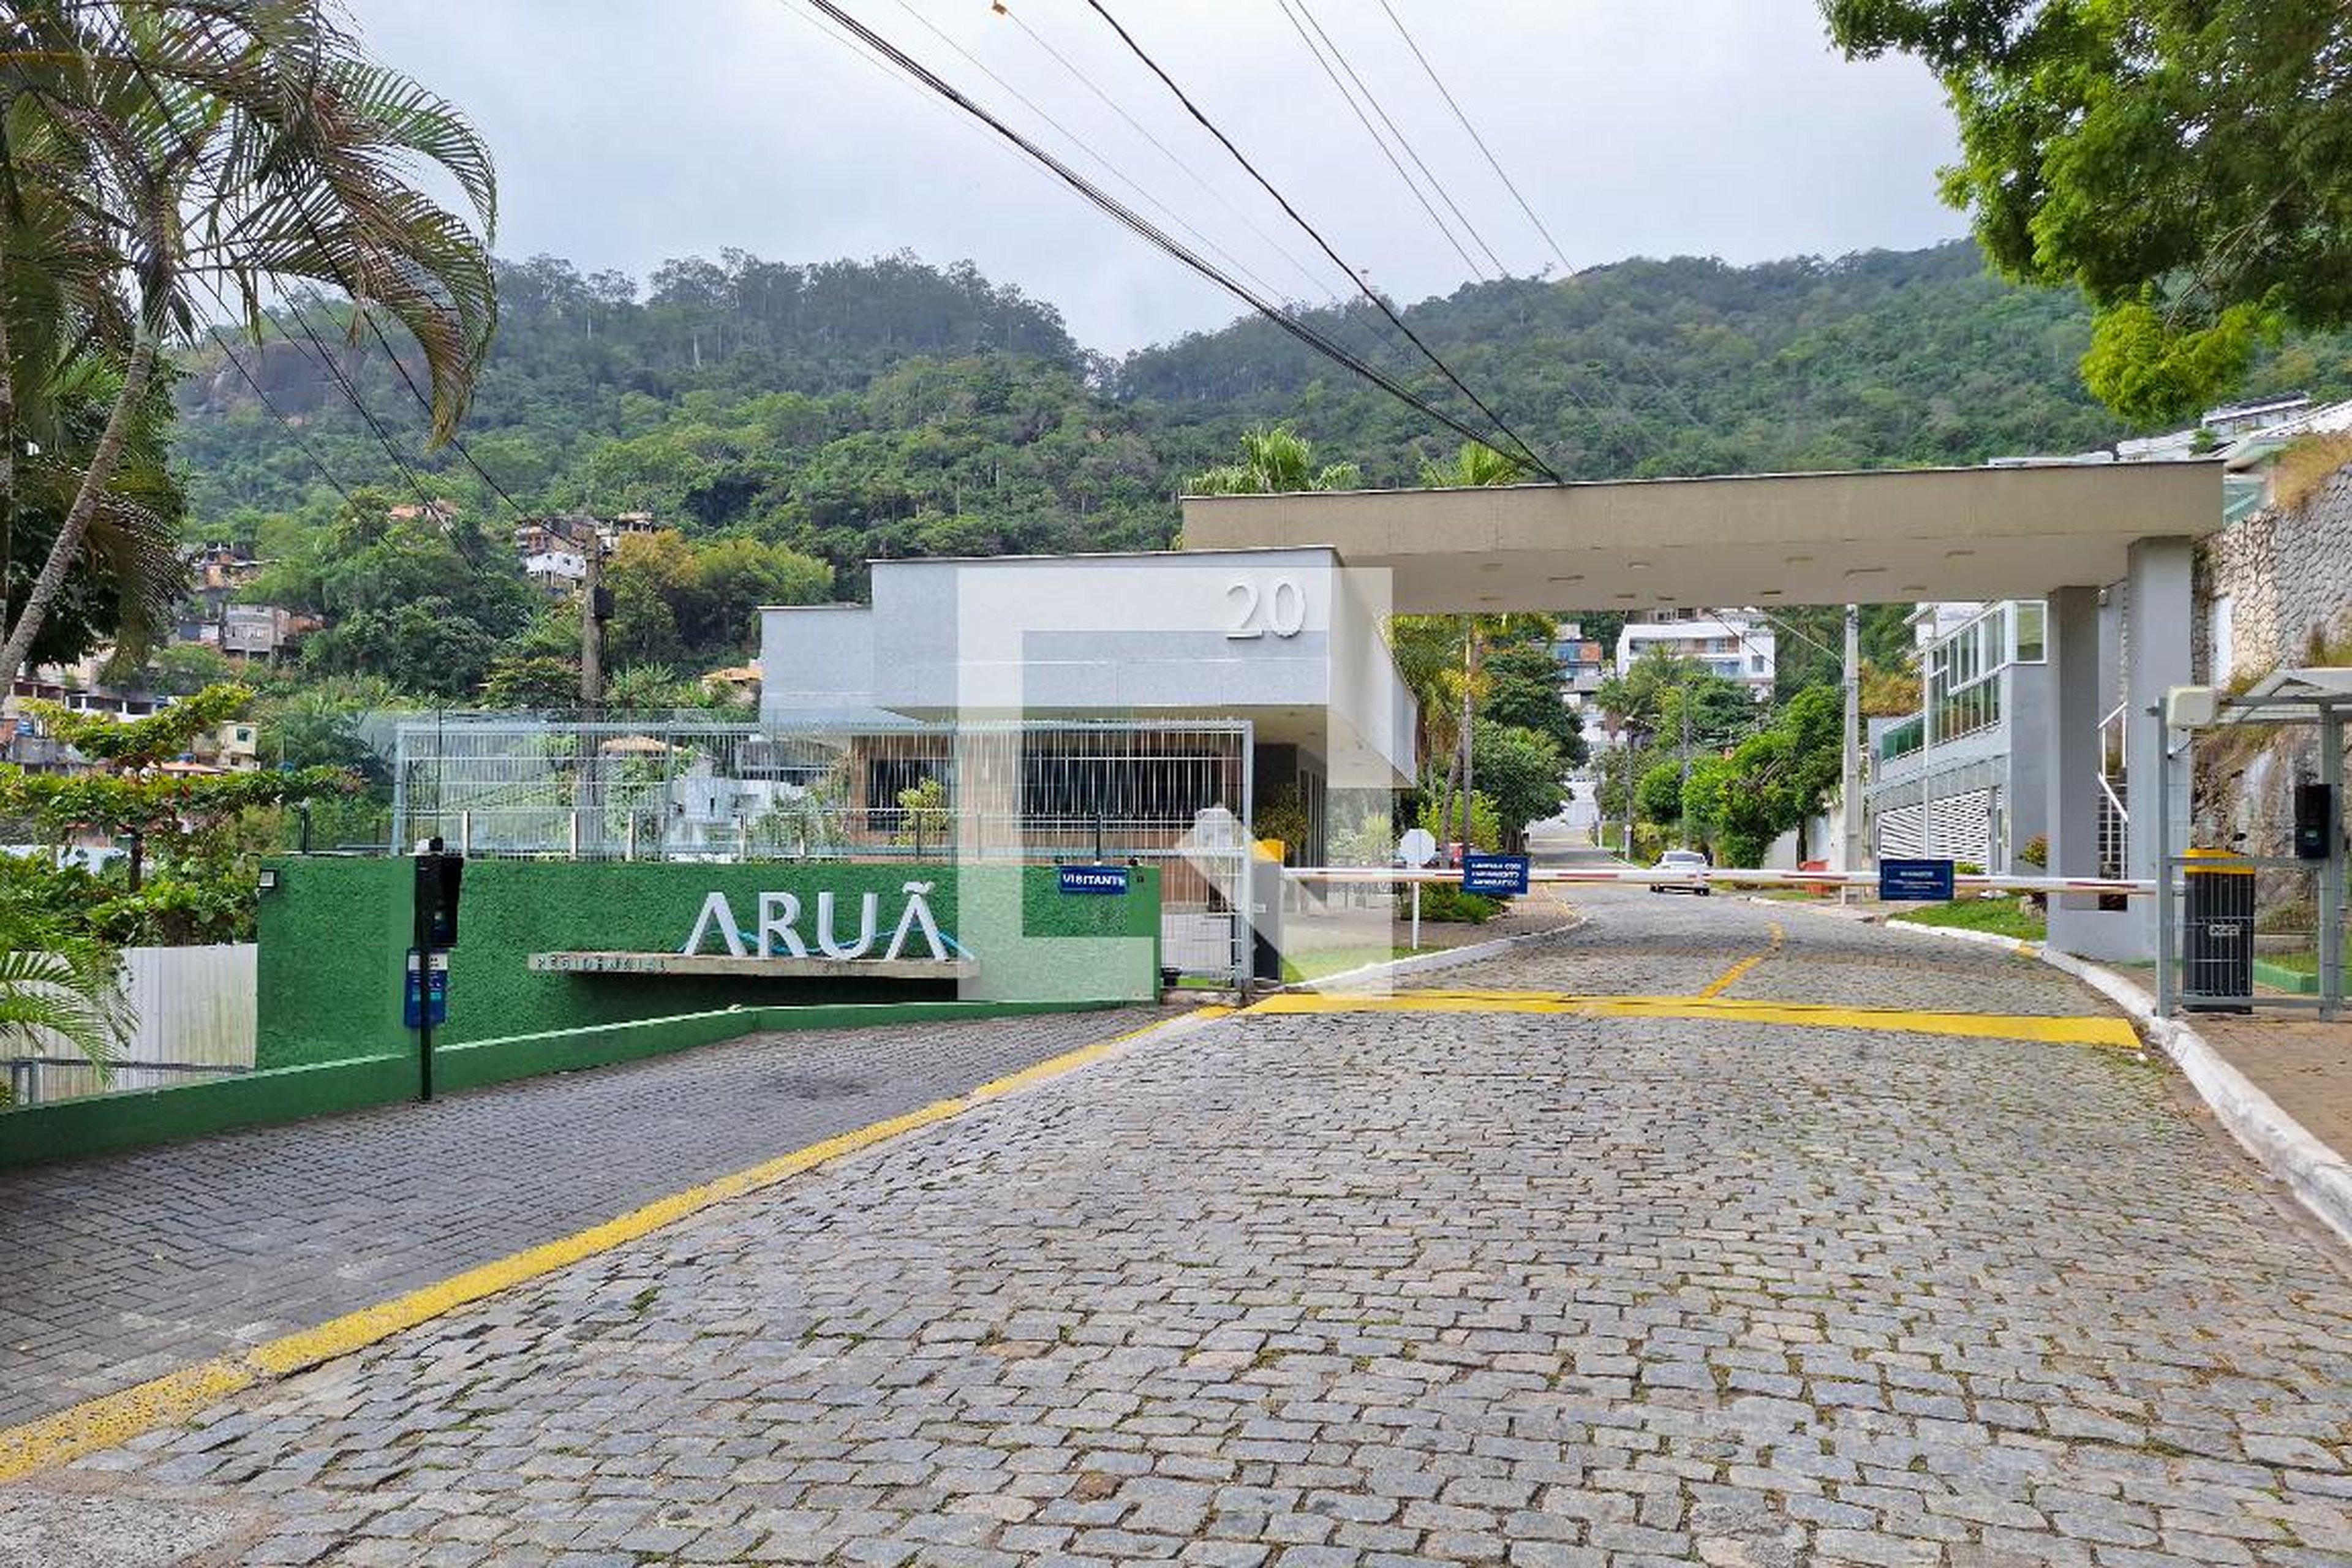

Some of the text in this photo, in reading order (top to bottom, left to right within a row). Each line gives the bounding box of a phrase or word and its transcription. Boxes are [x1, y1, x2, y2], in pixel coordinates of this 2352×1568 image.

[1226, 579, 1306, 640] 20
[1063, 874, 1126, 886] VISITANTE
[683, 881, 951, 960] ARUÃ
